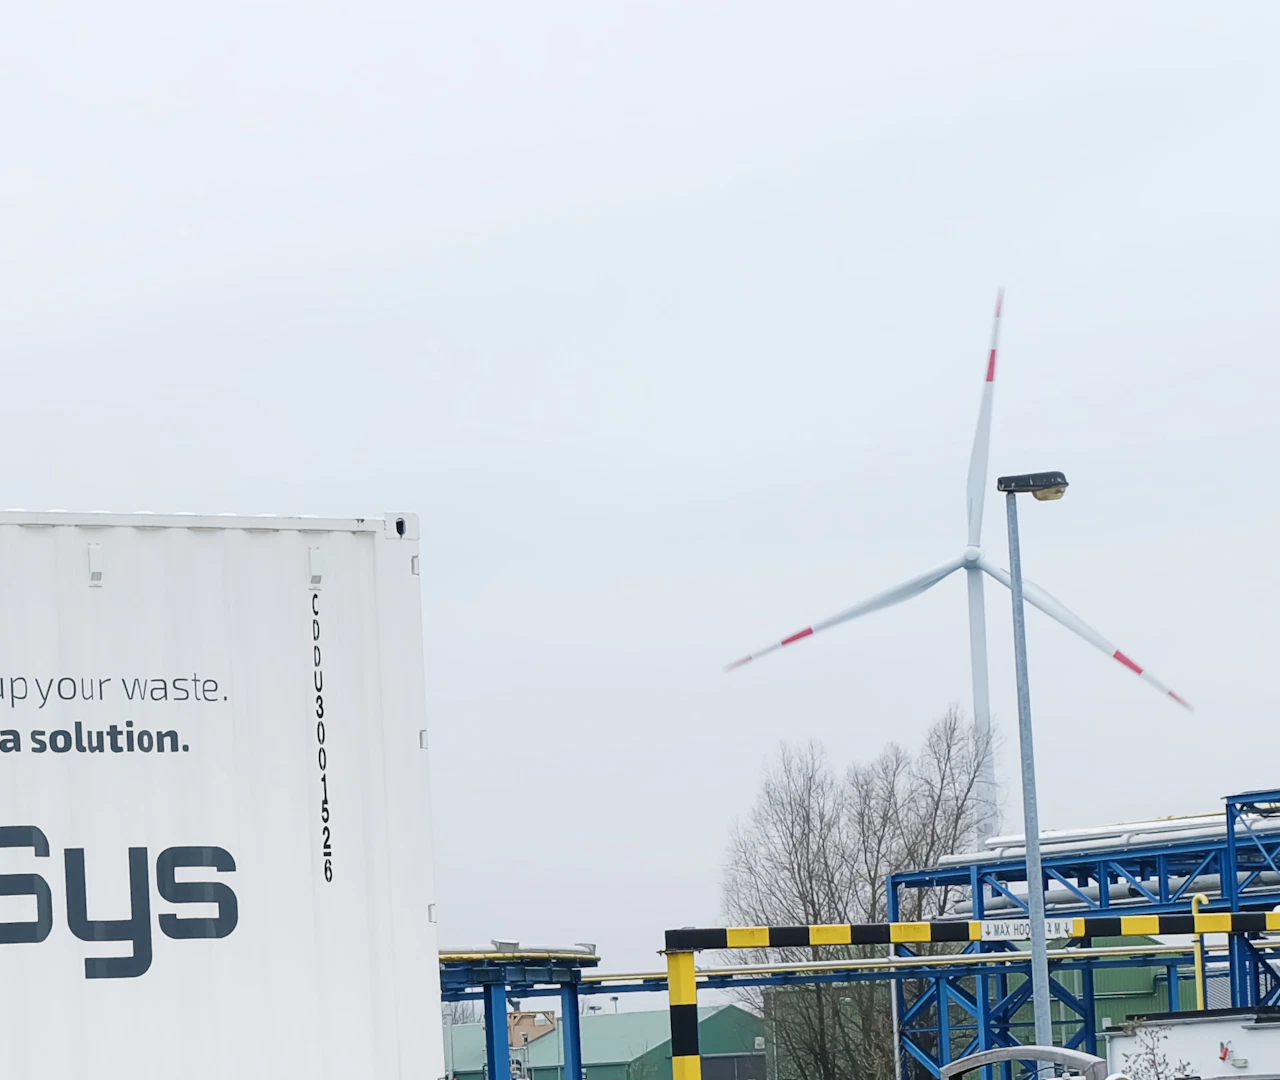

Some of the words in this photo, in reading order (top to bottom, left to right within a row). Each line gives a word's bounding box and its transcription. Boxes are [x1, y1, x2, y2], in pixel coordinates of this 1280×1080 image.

[35, 676, 111, 708] your
[122, 672, 228, 702] waste.
[0, 728, 22, 752] a
[31, 721, 190, 754] solution.
[994, 923, 1010, 936] MAX
